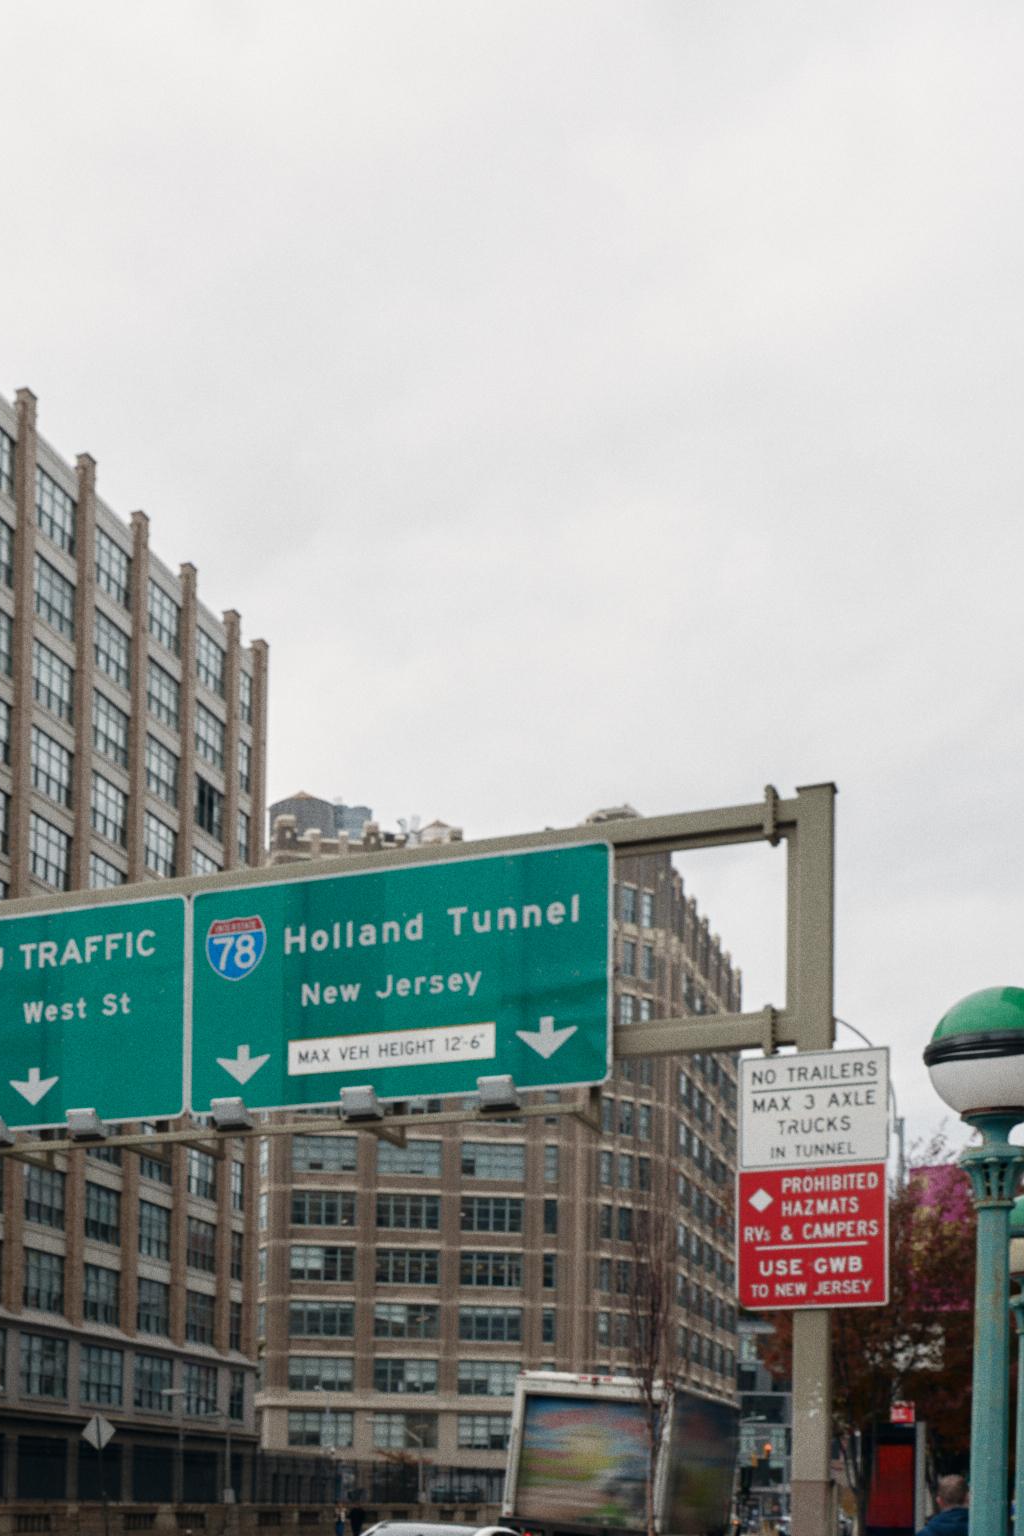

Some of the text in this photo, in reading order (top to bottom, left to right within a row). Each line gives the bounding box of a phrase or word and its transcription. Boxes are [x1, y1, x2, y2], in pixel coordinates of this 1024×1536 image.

[283, 894, 580, 955] Holland Tunnel
[19, 929, 156, 970] TRAFFIC
[212, 934, 256, 971] 78
[301, 970, 482, 1007] New Jersey
[23, 992, 131, 1024] West St
[297, 1049, 330, 1064] MAX
[339, 1045, 369, 1061] VEH
[377, 1038, 435, 1058] HEIGHT
[751, 1061, 878, 1086] NO TRAILERS
[752, 1089, 876, 1114] MAX 3 AXLE
[778, 1116, 851, 1136] TRUCKS
[770, 1141, 856, 1160] IN TUNNEL
[781, 1172, 878, 1194] PROHIBITED
[781, 1196, 859, 1217] HAZMATS
[780, 1224, 793, 1241] &
[802, 1220, 879, 1240] CAMPERS
[758, 1255, 863, 1277] USE GWB
[751, 1279, 872, 1298] TO NEW JERSEY
